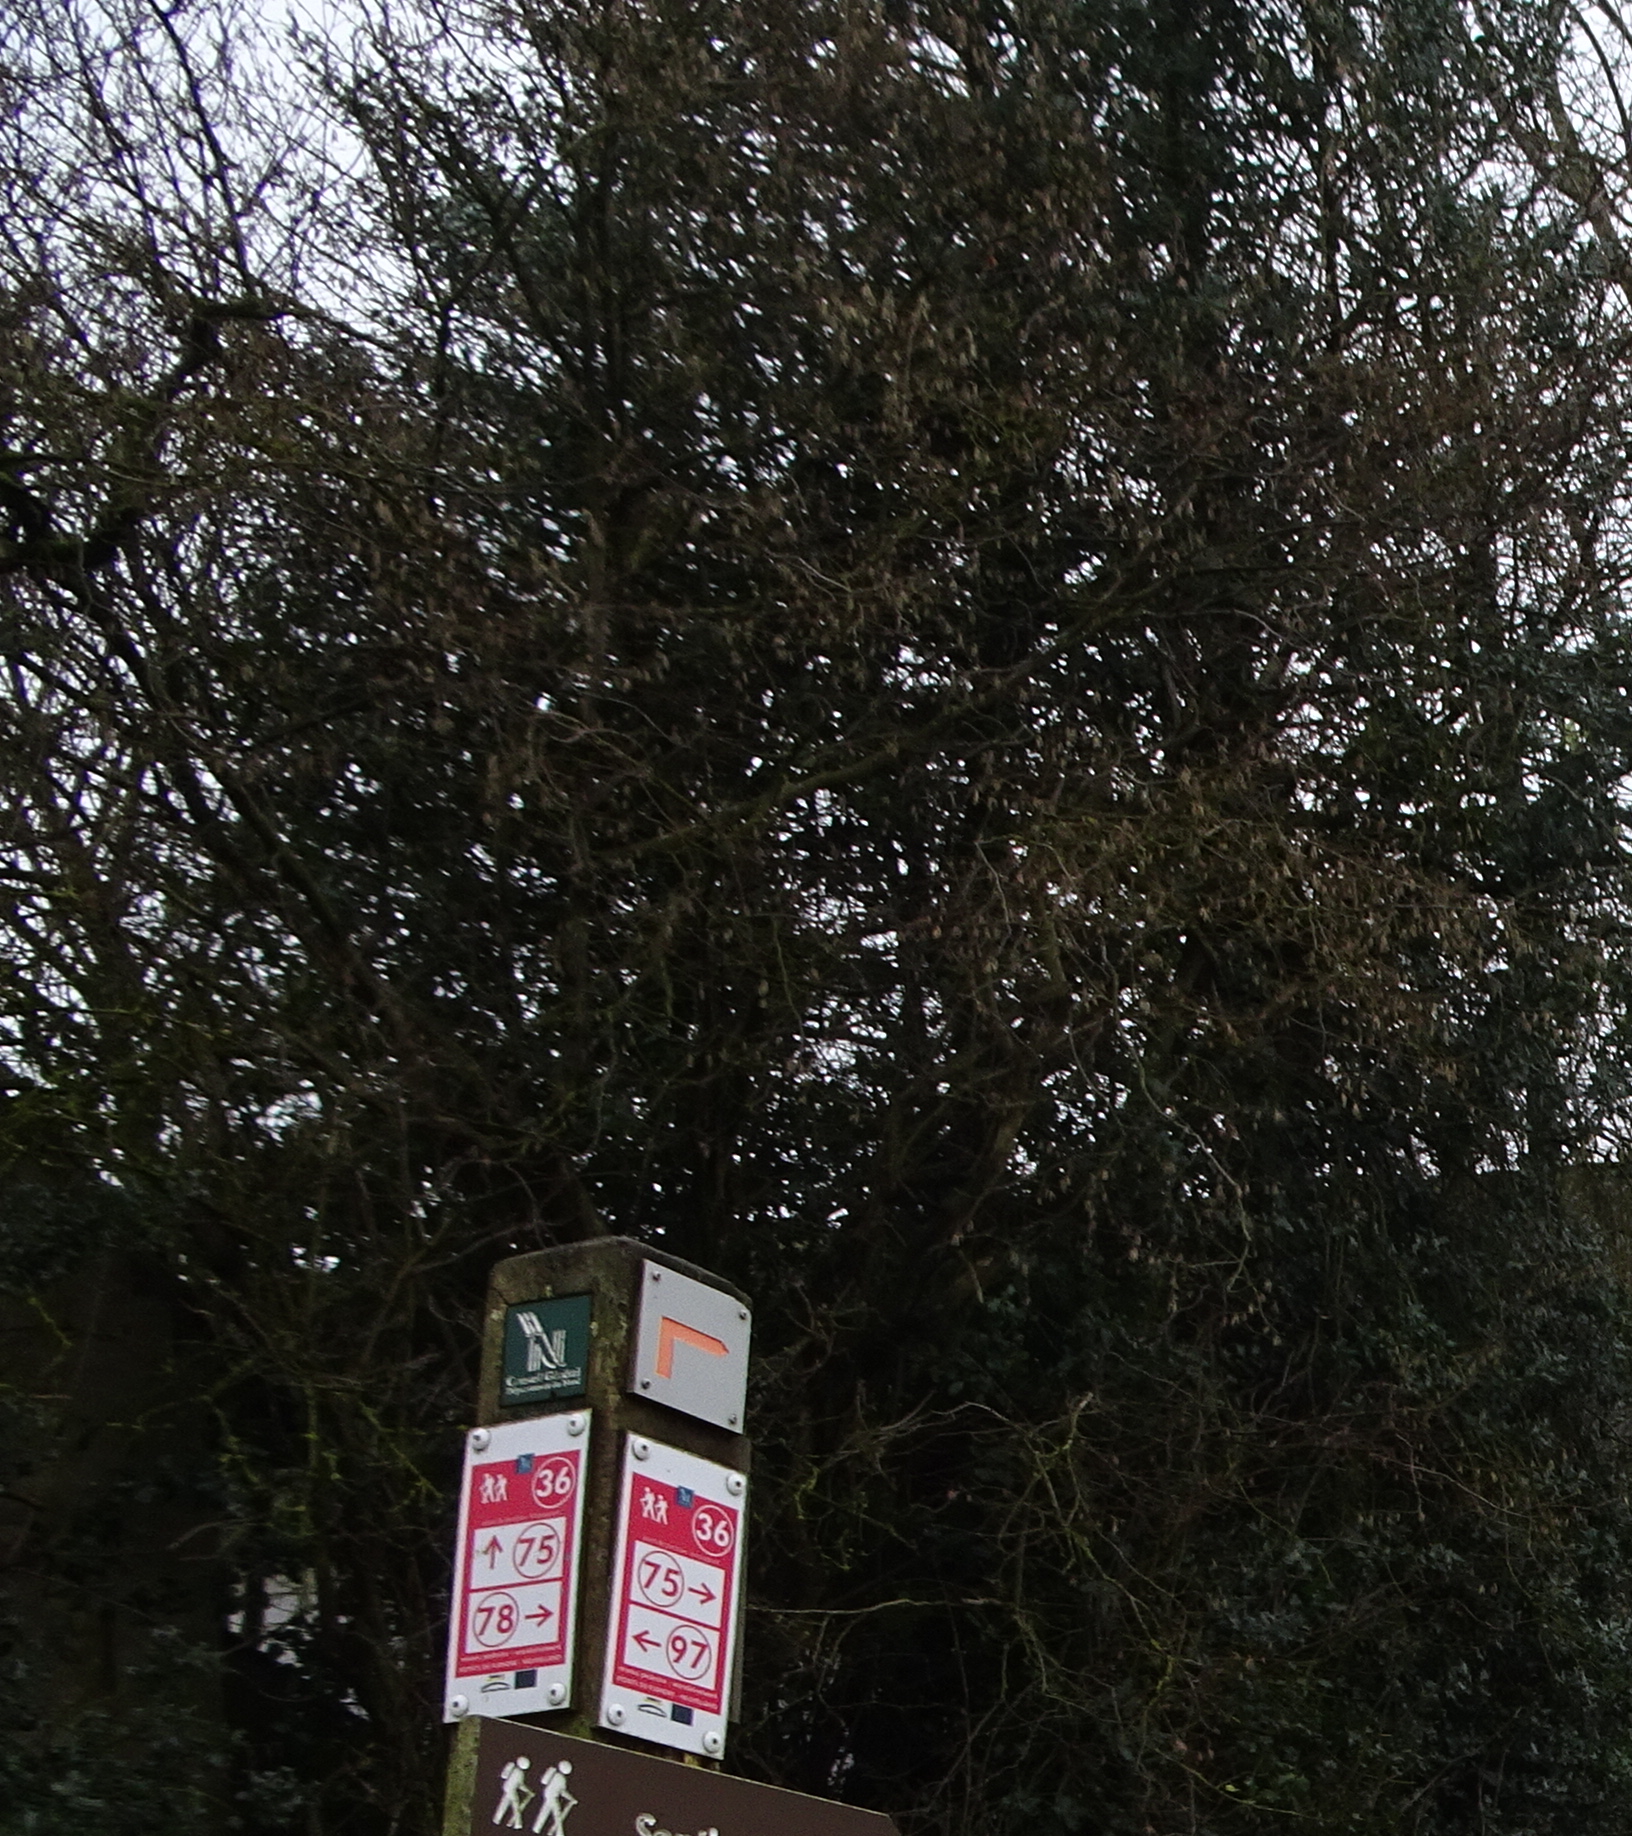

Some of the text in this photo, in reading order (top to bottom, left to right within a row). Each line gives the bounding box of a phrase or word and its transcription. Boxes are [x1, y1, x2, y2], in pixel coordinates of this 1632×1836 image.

[536, 1466, 571, 1497] 36
[696, 1512, 730, 1547] 36
[518, 1535, 555, 1567] 75
[644, 1560, 680, 1597] 75
[477, 1604, 513, 1636] 78
[671, 1635, 708, 1669] 97
